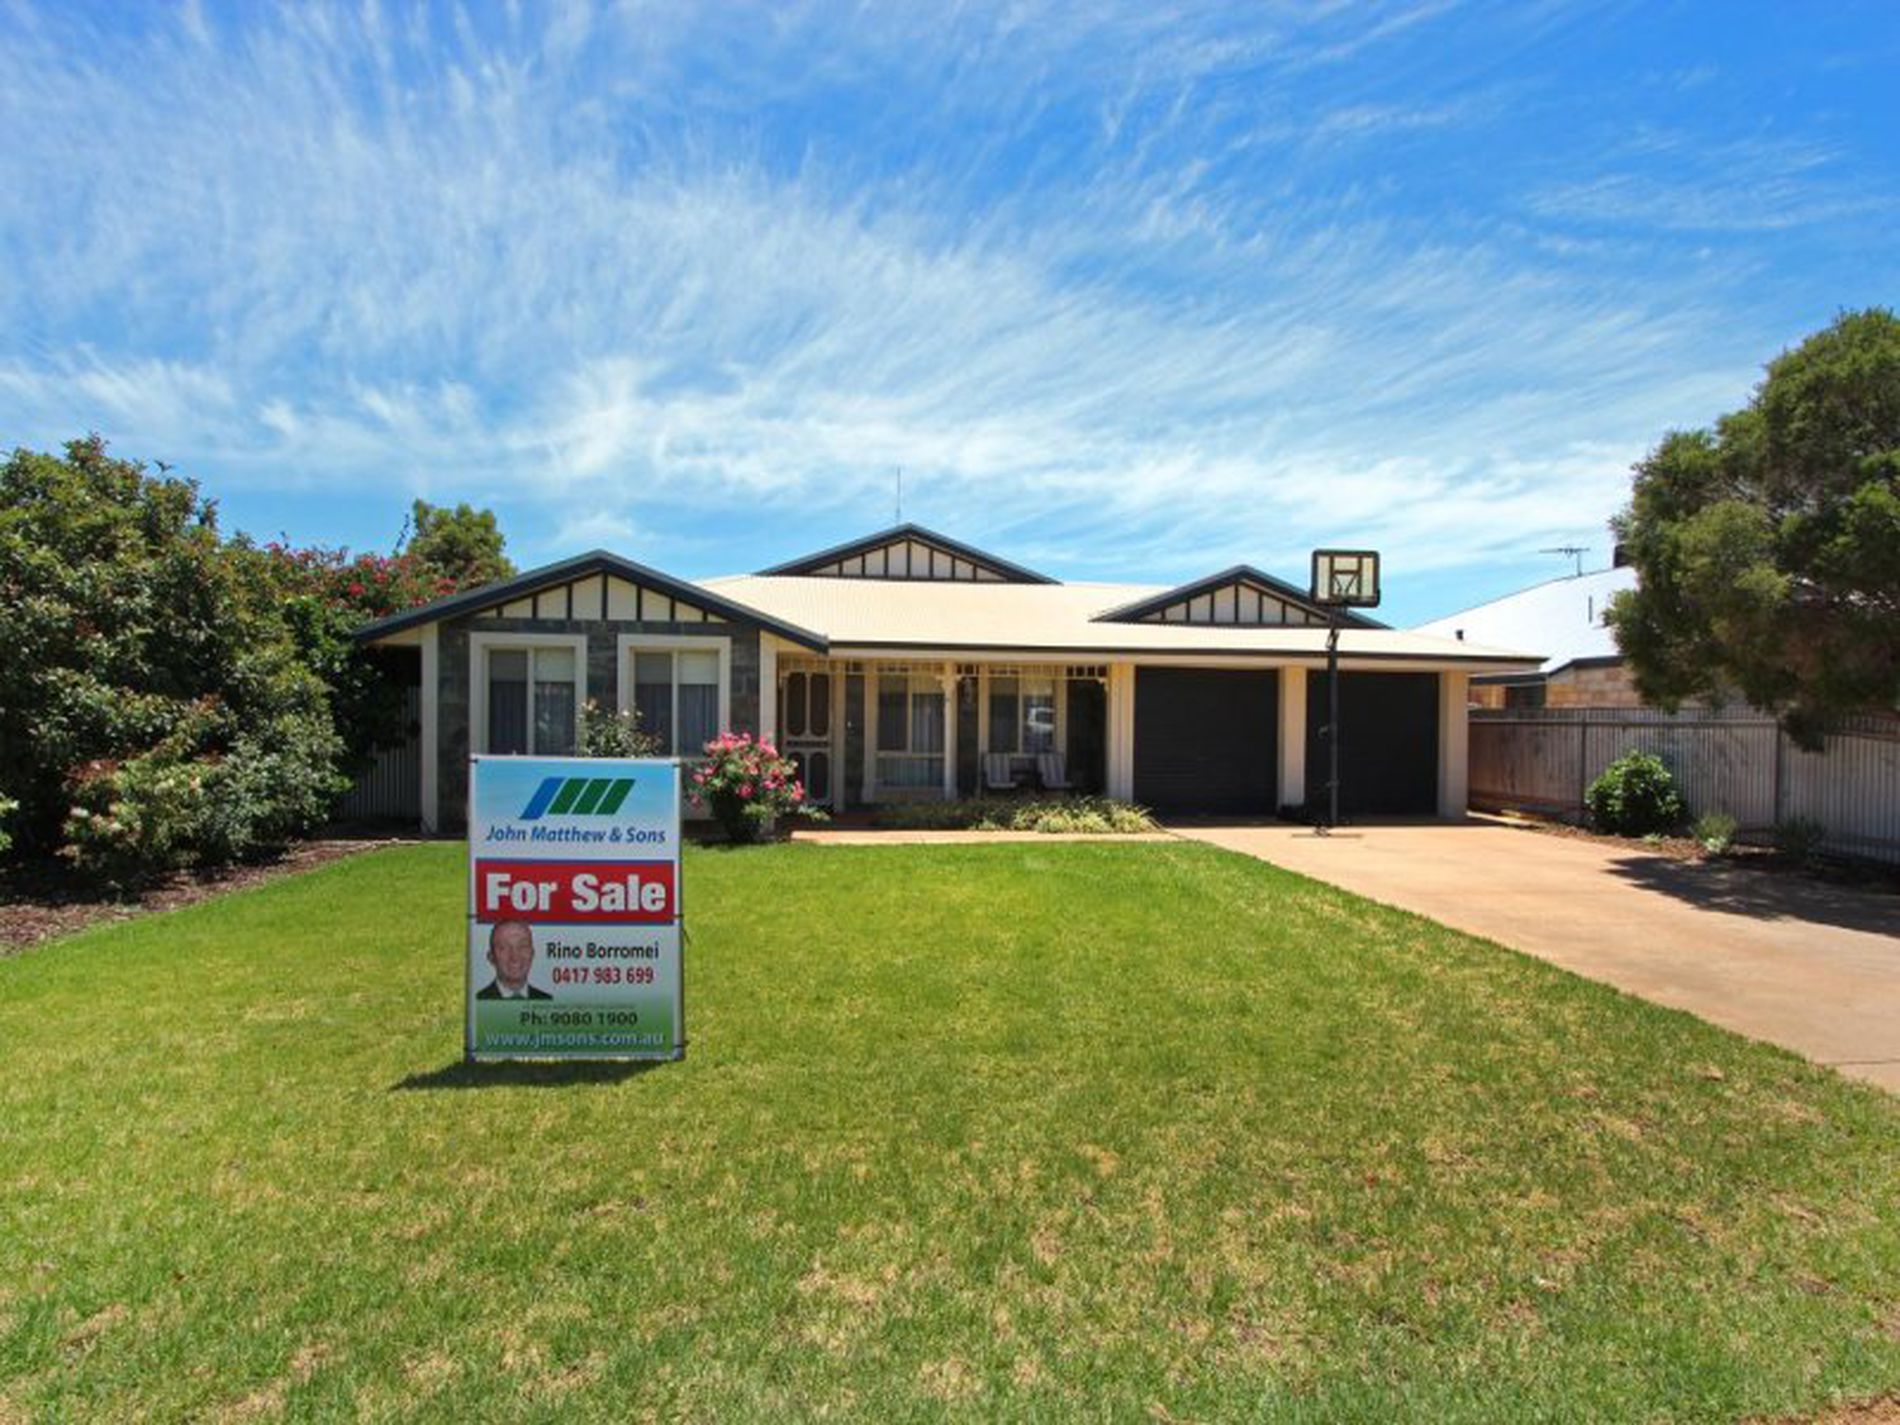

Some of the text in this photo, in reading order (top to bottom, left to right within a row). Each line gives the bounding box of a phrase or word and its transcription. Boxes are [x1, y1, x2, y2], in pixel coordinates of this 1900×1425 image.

[486, 824, 666, 844] John Matthew & Sons
[486, 873, 666, 912] For Sale
[546, 942, 659, 959] Rino Borromei
[552, 967, 654, 984] 0417 983 699
[598, 1011, 638, 1026] 1900
[486, 1032, 664, 1049] www.jmsons.com.au
